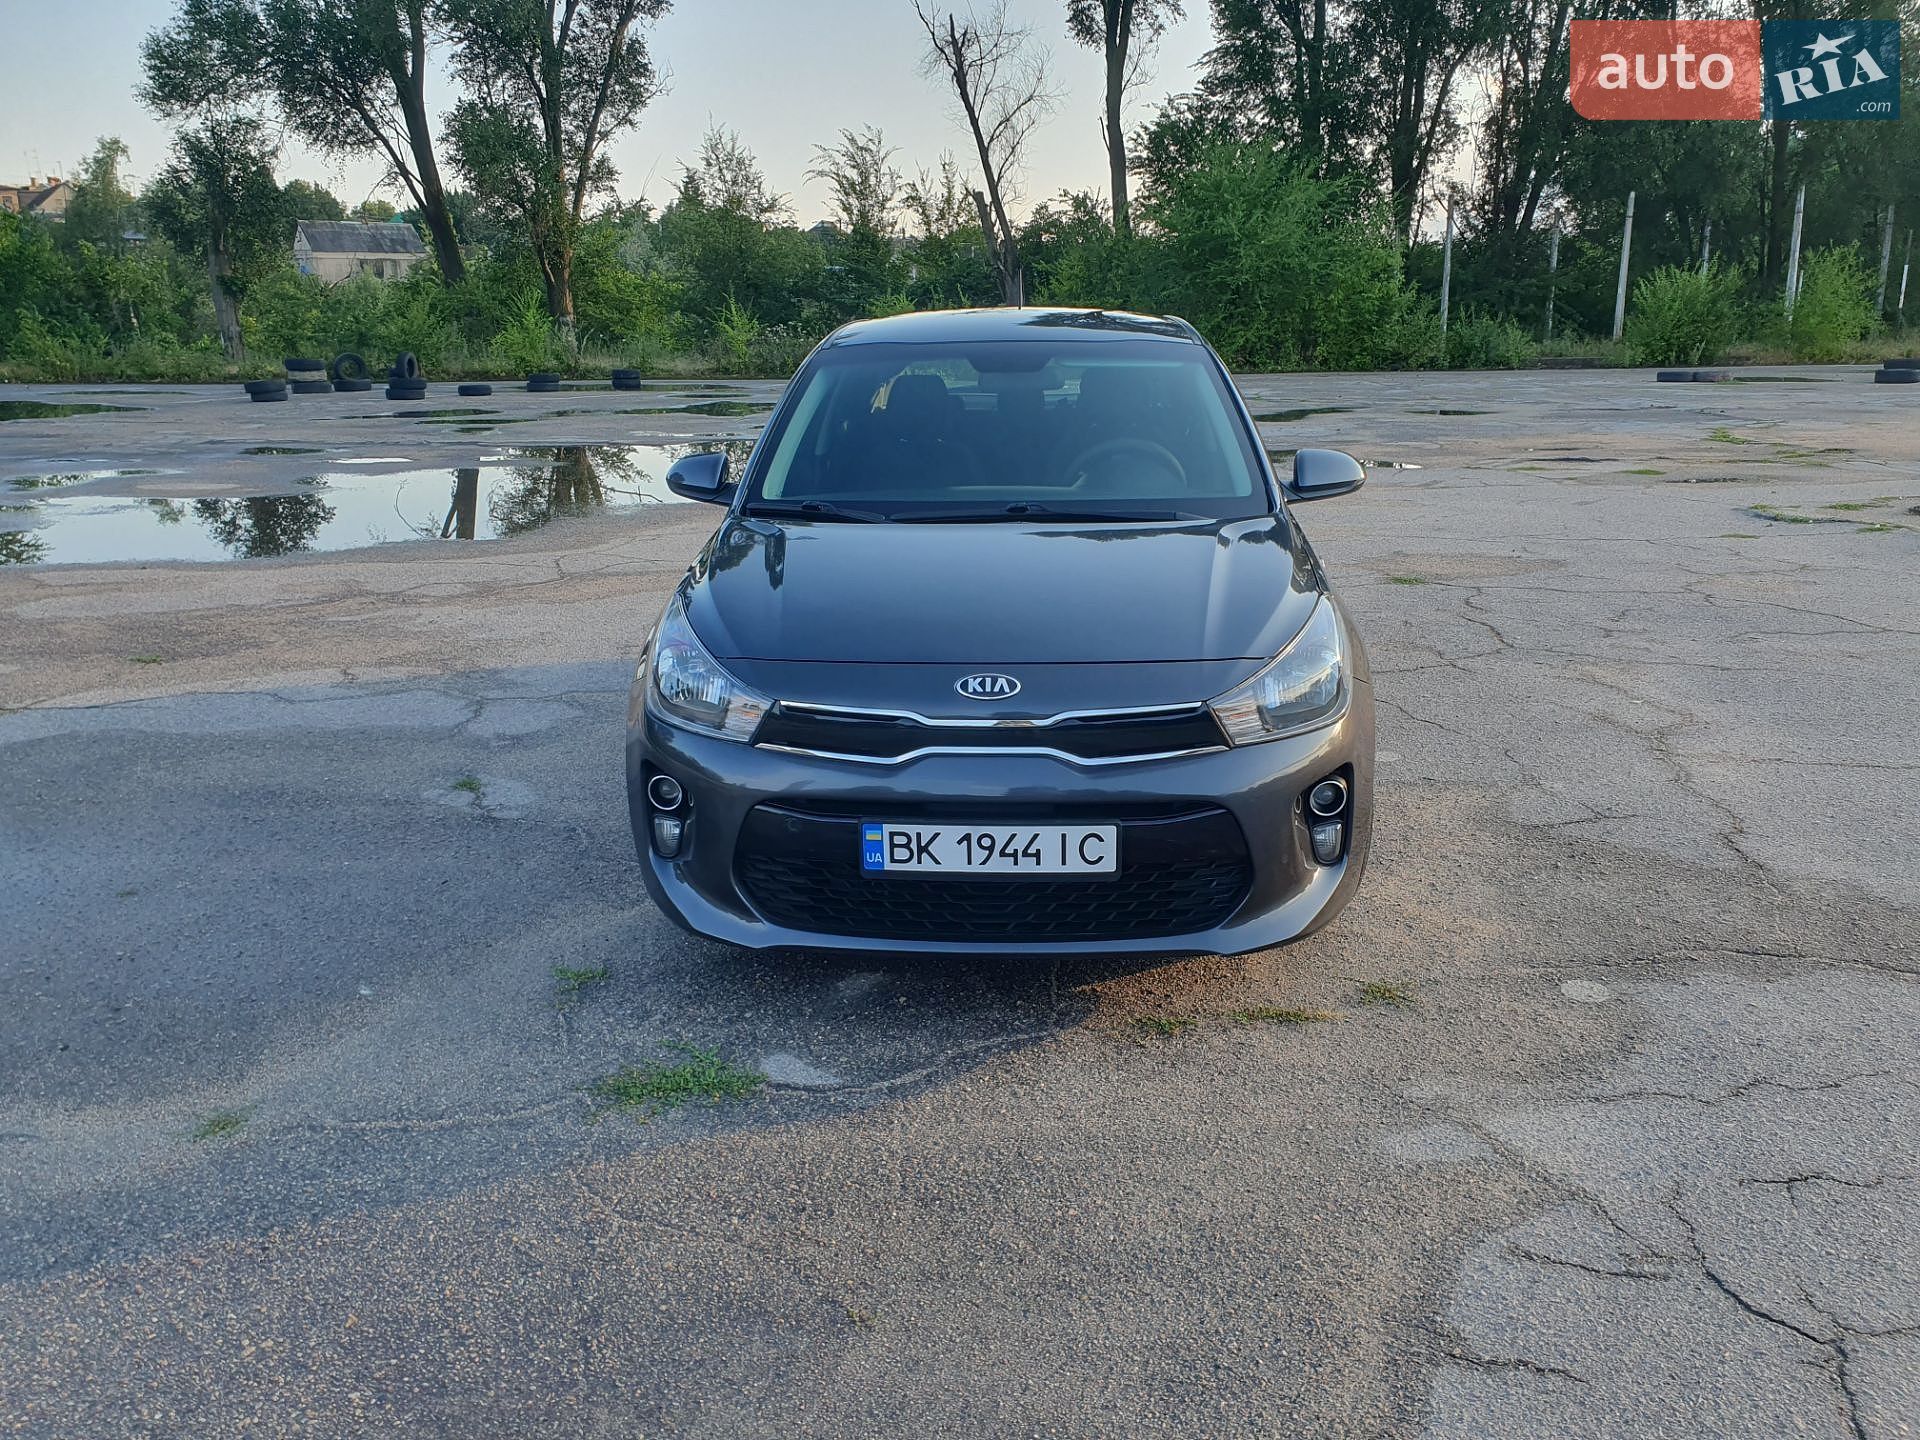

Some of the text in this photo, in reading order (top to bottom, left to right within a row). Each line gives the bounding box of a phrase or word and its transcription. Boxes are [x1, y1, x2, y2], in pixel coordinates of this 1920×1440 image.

[967, 677, 1011, 693] KIA
[888, 831, 1105, 866] BK 1944 IC
[866, 852, 883, 863] UA
